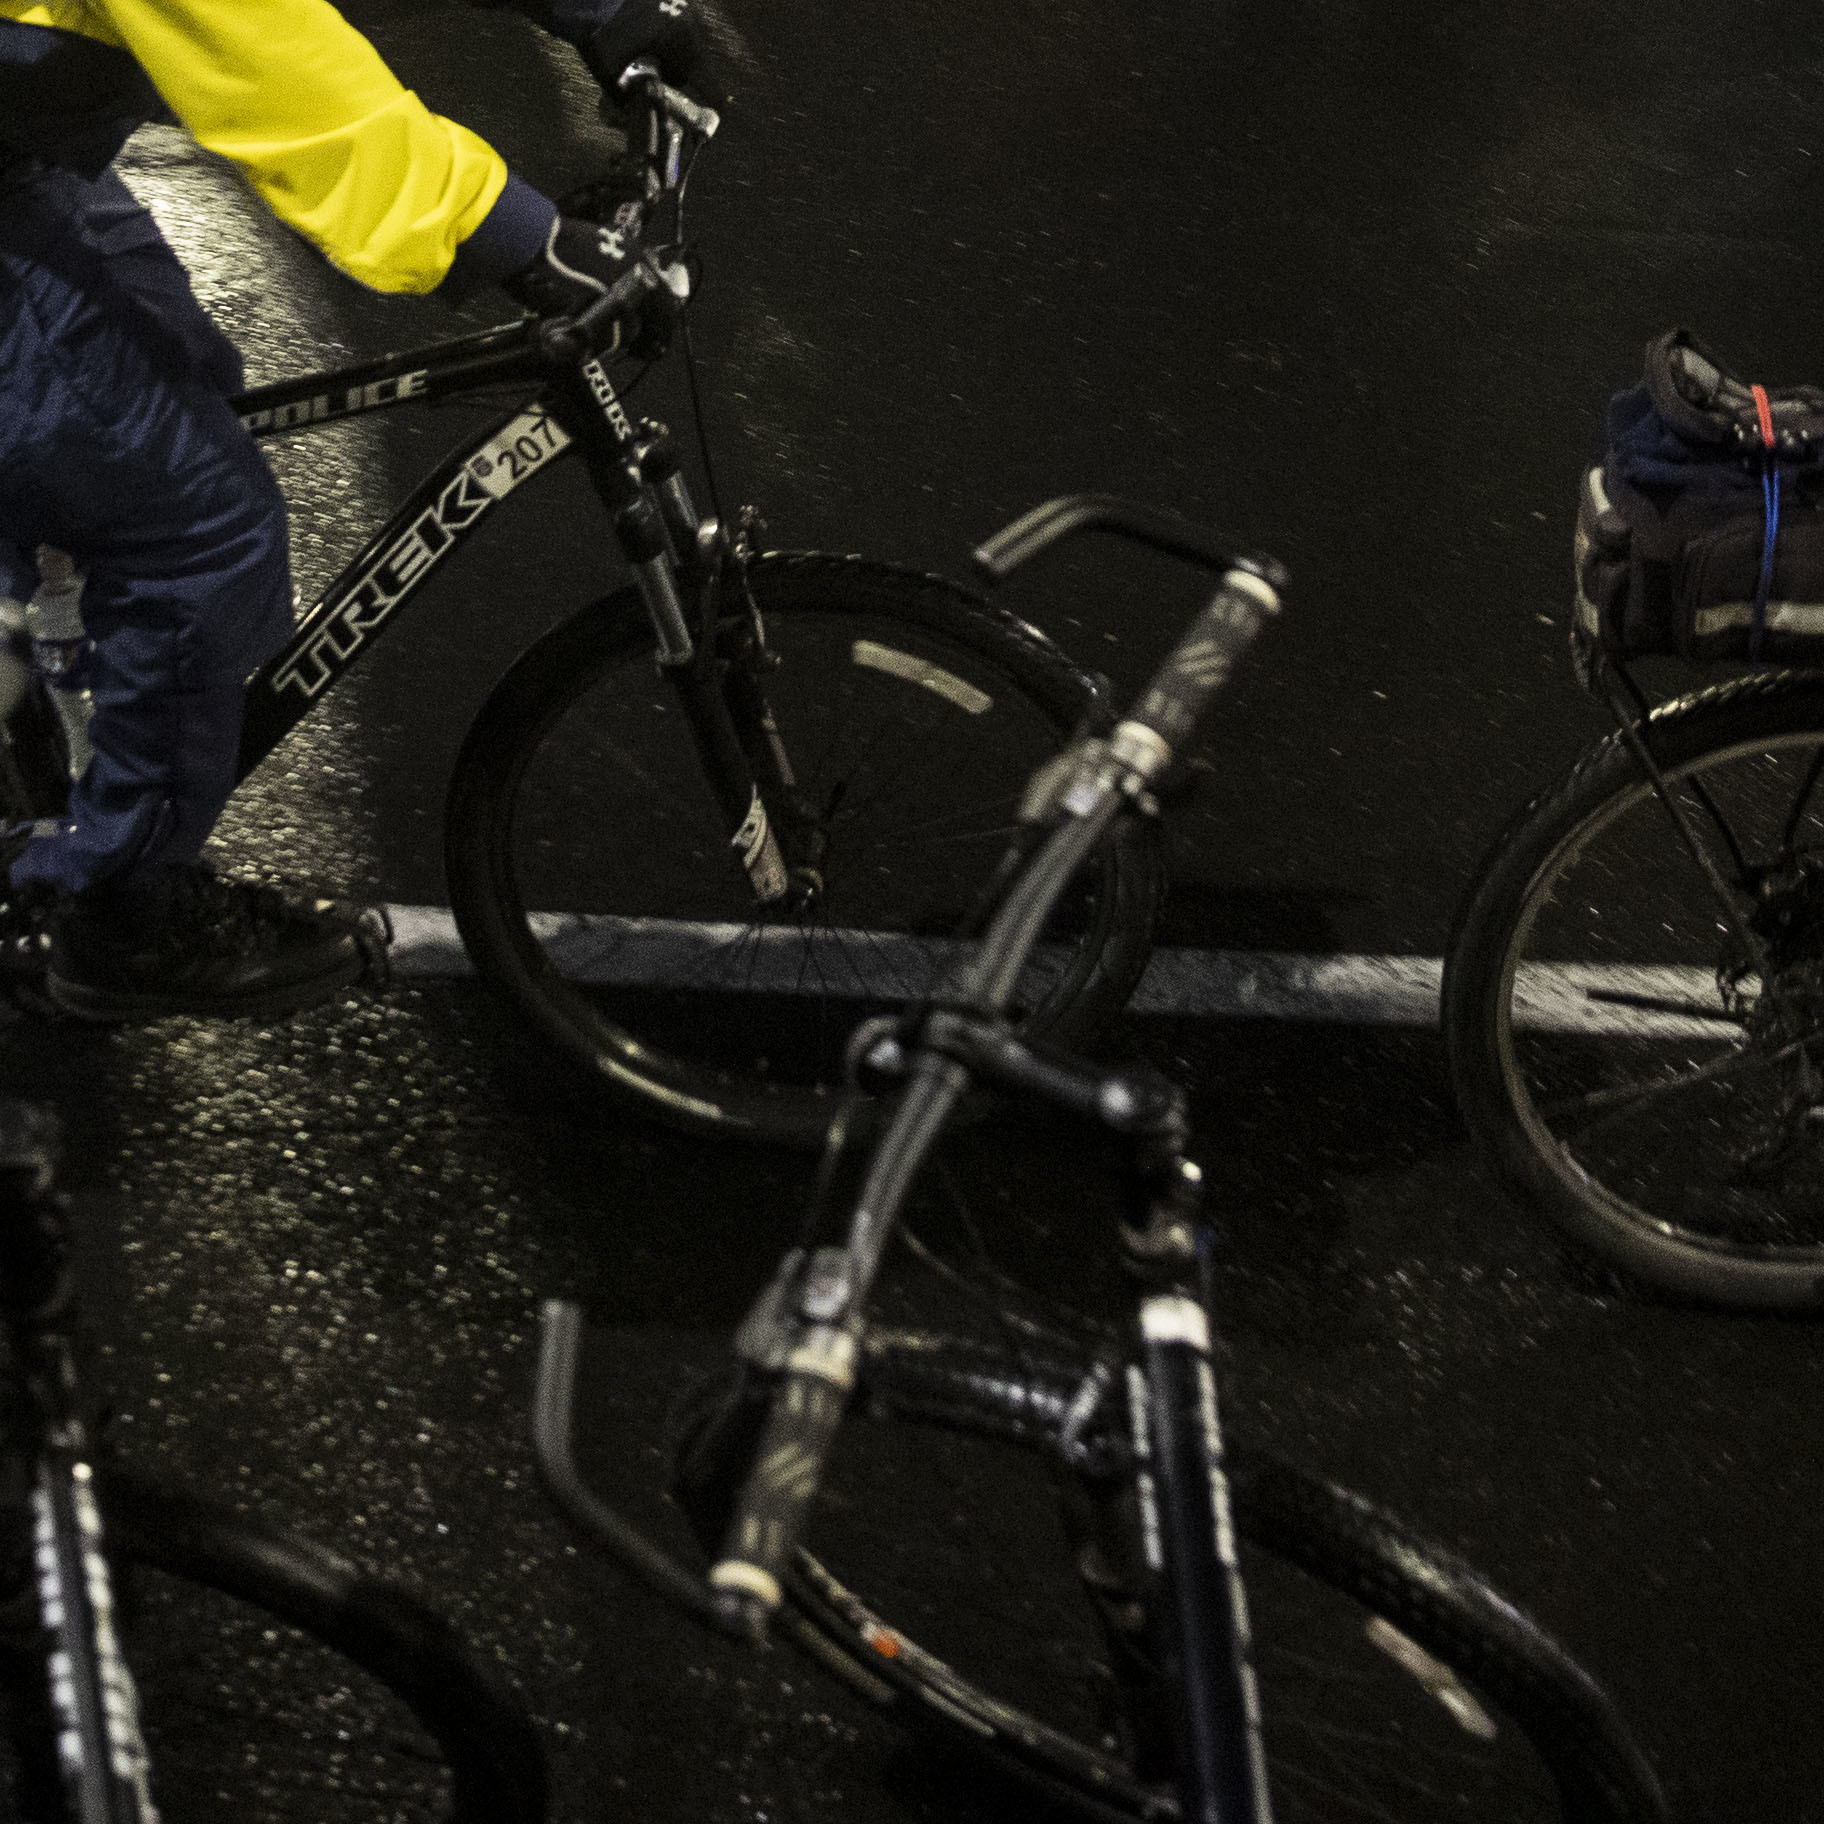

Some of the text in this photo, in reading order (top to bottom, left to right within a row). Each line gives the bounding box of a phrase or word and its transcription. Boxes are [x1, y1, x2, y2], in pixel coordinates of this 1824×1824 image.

[240, 368, 430, 433] POLICE
[496, 416, 560, 481] 207
[271, 469, 494, 697] TREK
